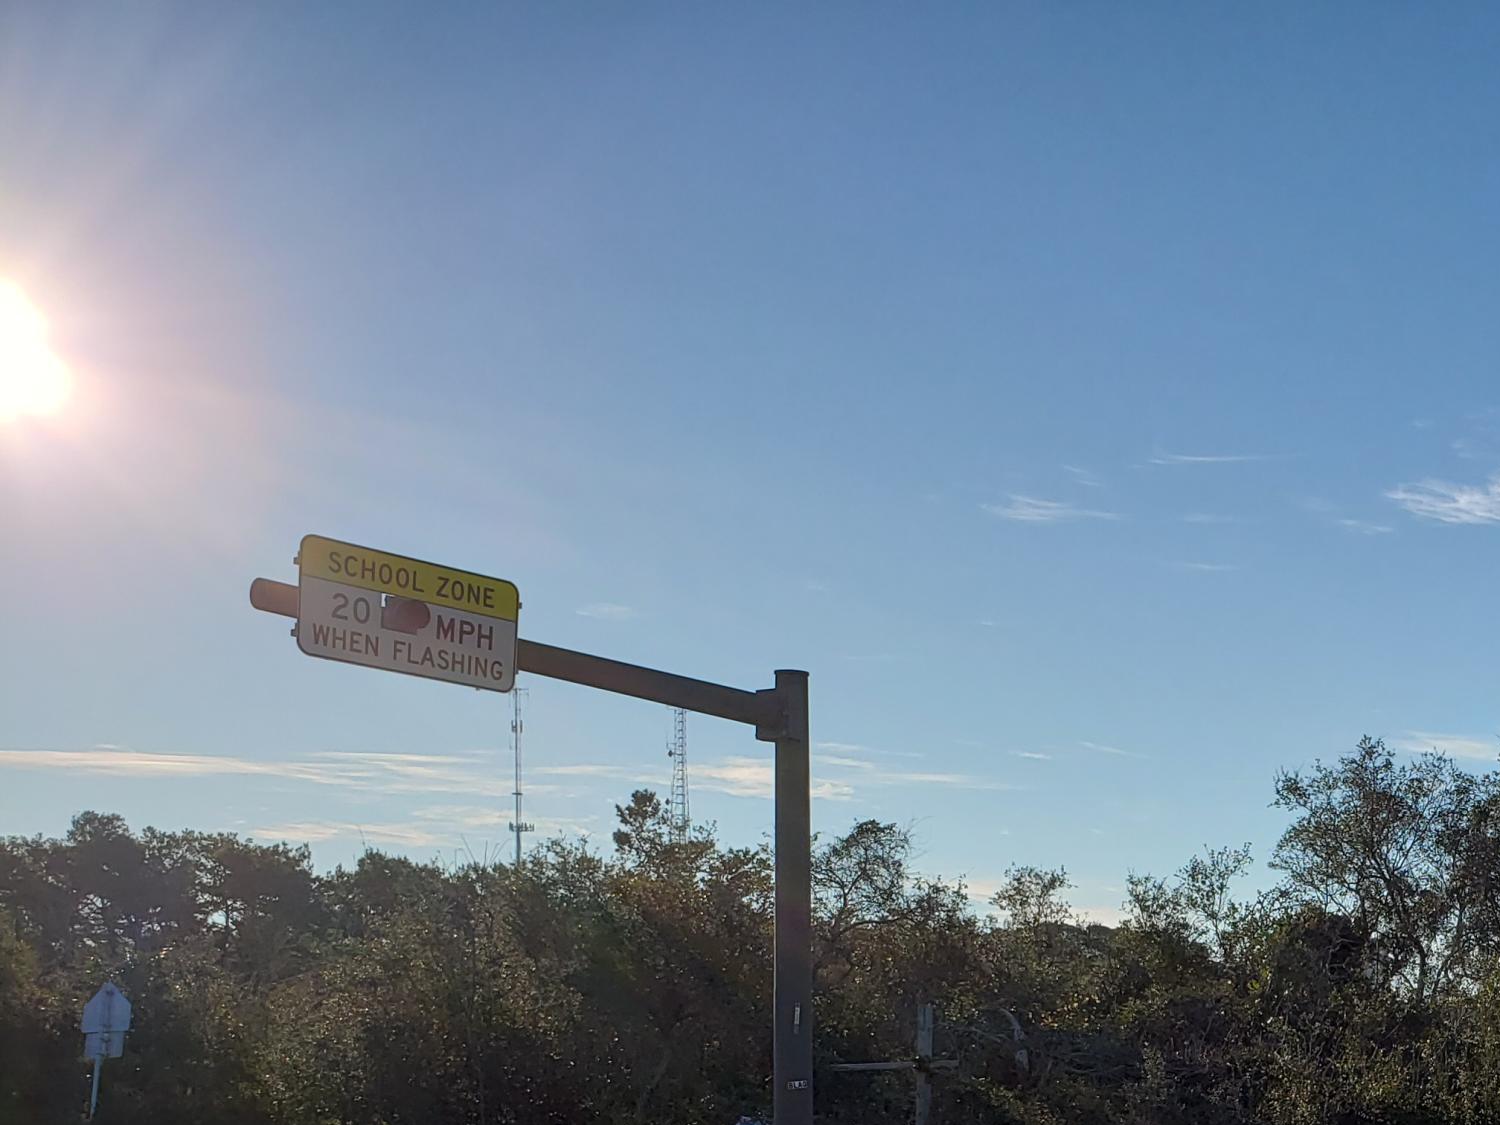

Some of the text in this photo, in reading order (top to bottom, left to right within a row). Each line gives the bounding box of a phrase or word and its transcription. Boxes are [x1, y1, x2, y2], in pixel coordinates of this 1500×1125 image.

[329, 552, 495, 609] SCHOOL ZONE
[331, 592, 494, 651] 20 MPH
[312, 623, 503, 681] WHEN FLASHING
